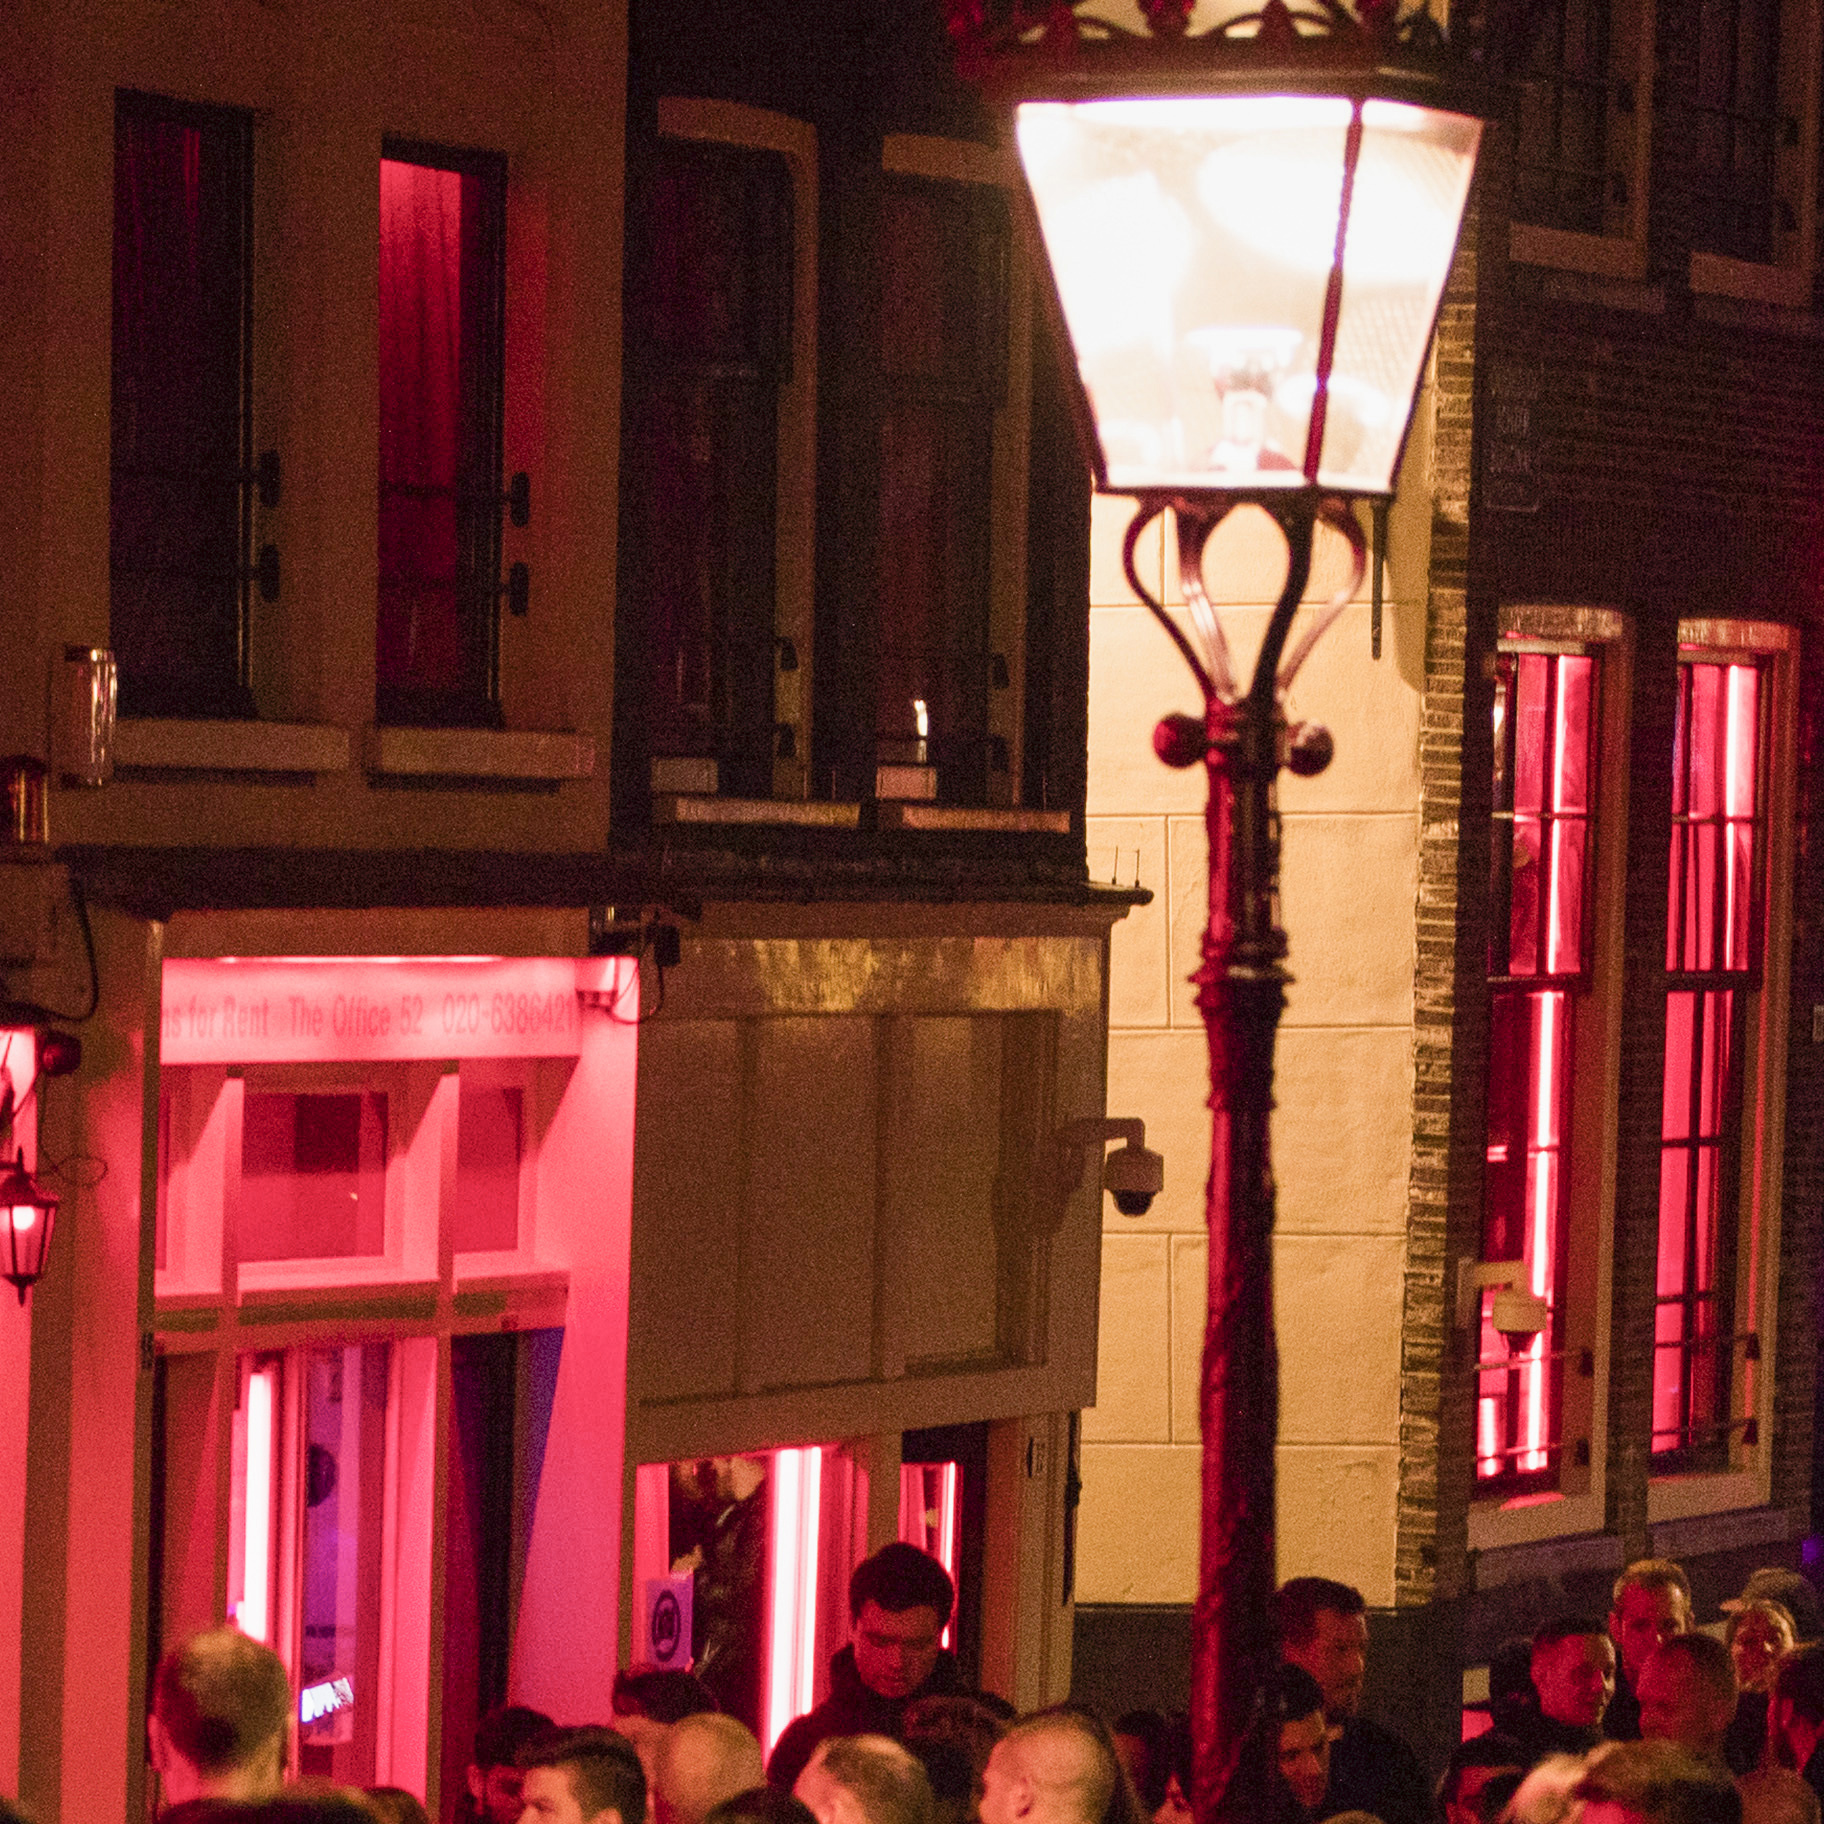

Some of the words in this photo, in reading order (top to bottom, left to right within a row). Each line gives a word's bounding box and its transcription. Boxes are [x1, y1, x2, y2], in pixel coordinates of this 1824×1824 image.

[223, 994, 270, 1039] Rent
[289, 994, 324, 1037] The
[333, 992, 390, 1037] Office
[399, 993, 423, 1037] 52
